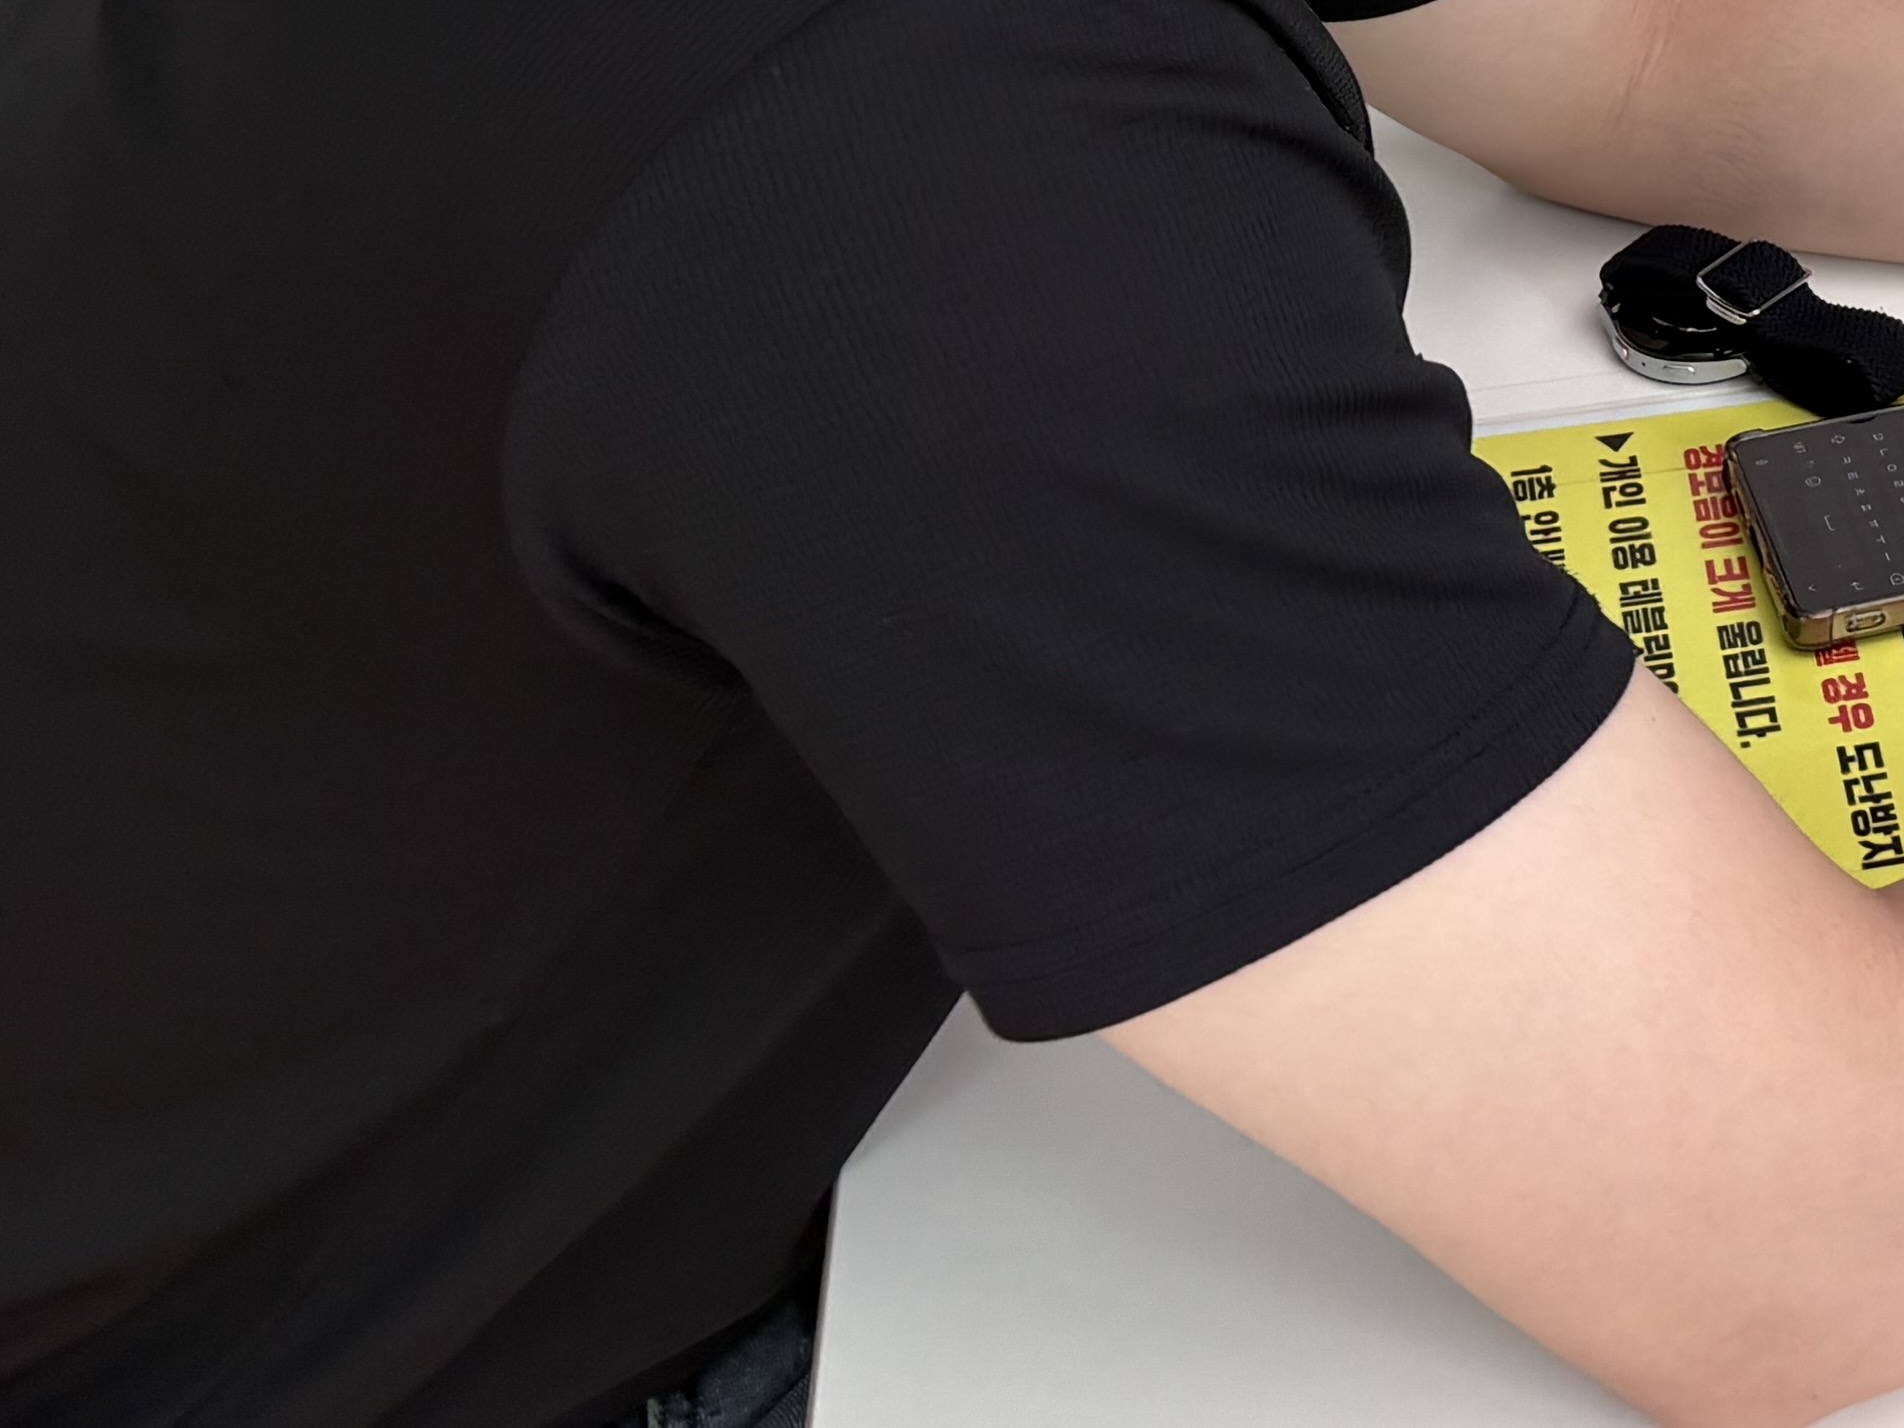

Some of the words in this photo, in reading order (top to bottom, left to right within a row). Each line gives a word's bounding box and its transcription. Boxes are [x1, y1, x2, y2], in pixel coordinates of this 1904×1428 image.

[1509, 463, 1556, 503] 1층
[1597, 454, 1647, 510] 개인
[1607, 515, 1657, 571] 이용
[1704, 555, 1757, 614] 크게
[1617, 577, 1680, 696] 테블릿P
[1716, 620, 1783, 750] 울립니다.
[1820, 672, 1875, 733] 경우
